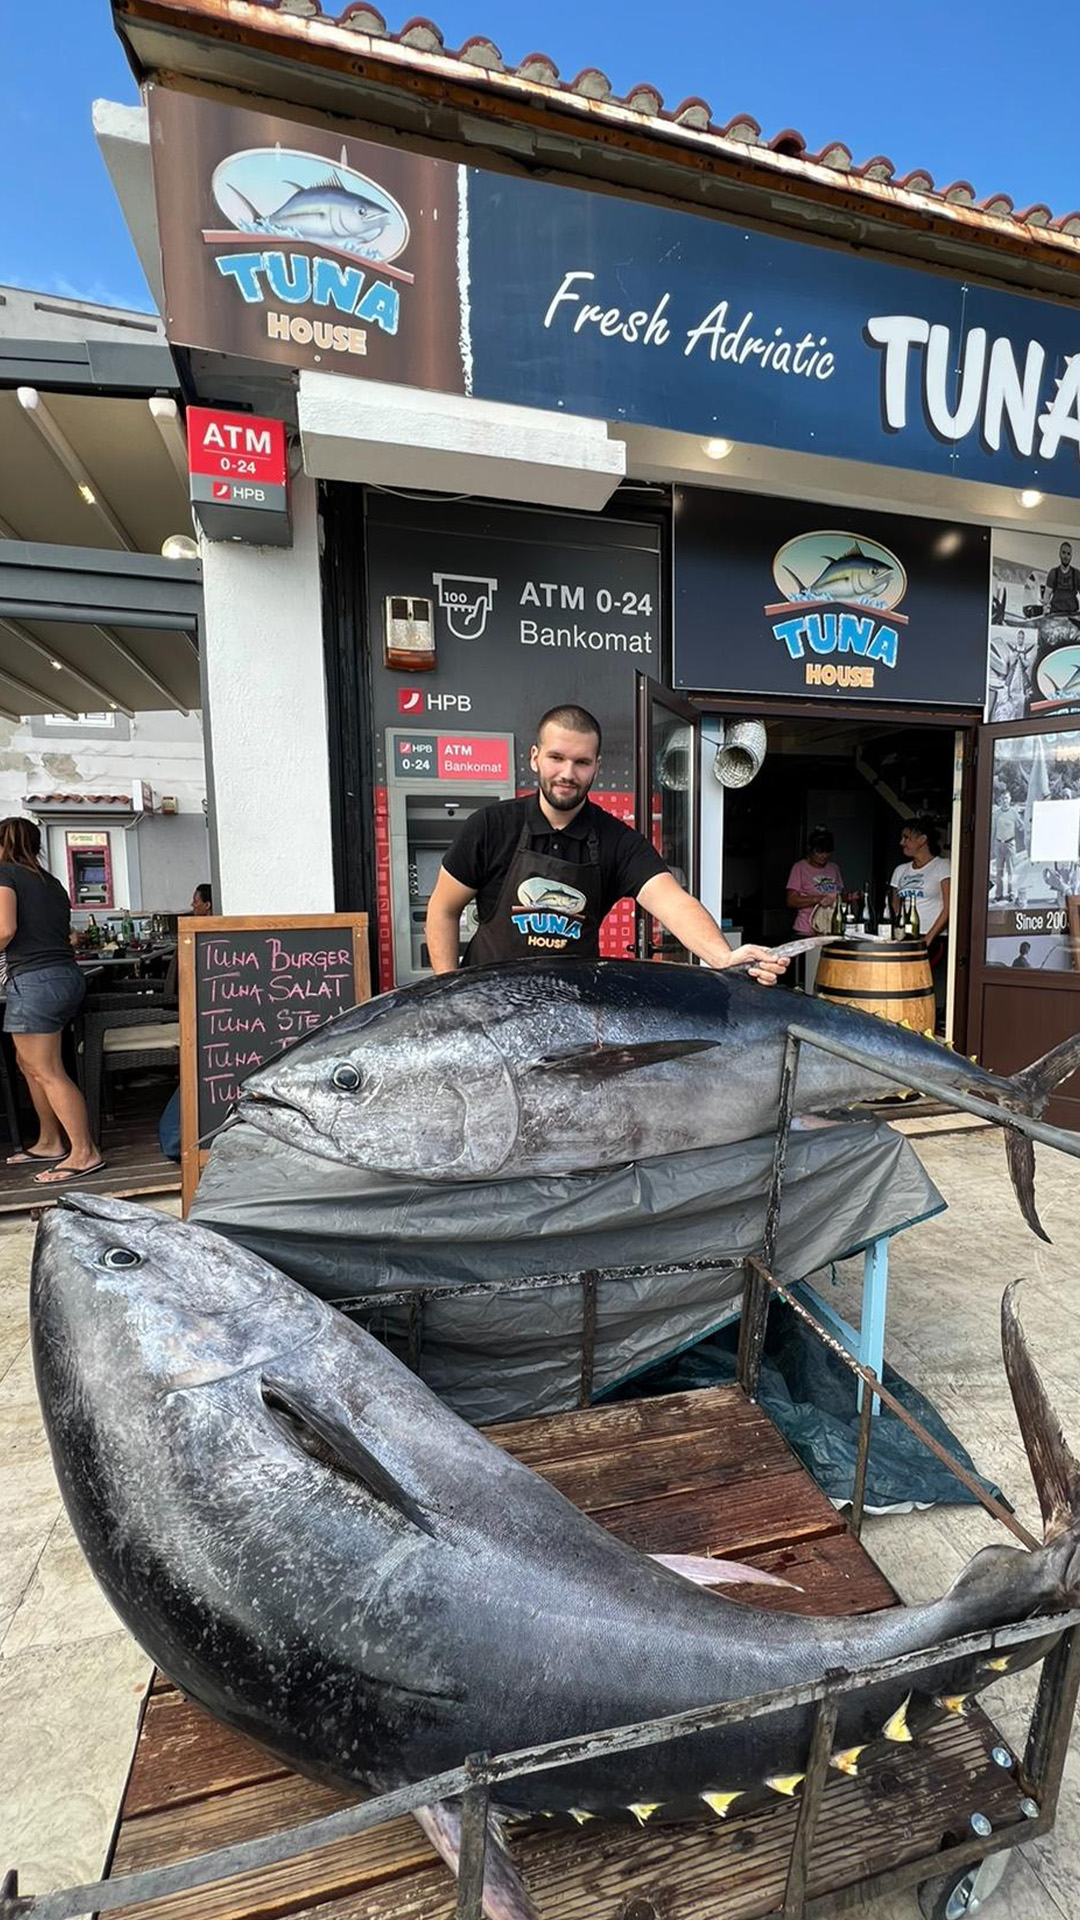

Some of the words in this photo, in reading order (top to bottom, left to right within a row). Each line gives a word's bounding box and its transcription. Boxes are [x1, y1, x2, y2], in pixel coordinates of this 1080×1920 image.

[216, 251, 400, 336] TUNA
[267, 311, 367, 355] HOUSE
[544, 271, 670, 346] Fresh
[684, 301, 835, 380] Adriatic
[202, 422, 271, 454] ATM
[220, 457, 256, 474] 0-24
[233, 486, 265, 501] HPB
[443, 591, 467, 603] 100
[519, 581, 585, 611] ATM
[596, 589, 653, 617] 0-24
[519, 619, 652, 653] Bankomat
[772, 612, 899, 669] TUNA
[805, 662, 874, 688] HOUSE
[427, 694, 472, 712] HPB
[412, 744, 433, 753] HPB
[444, 744, 472, 756] ATM
[402, 758, 430, 770] 0-24
[444, 760, 502, 773] Bankomat
[511, 912, 583, 940] TUNA
[1015, 911, 1044, 930] Since
[1046, 911, 1069, 929] 200
[200, 940, 260, 970] TUNA
[265, 938, 352, 972] BURGER
[527, 935, 568, 949] HOUSE
[202, 972, 264, 1005] TUNA
[268, 974, 349, 1002] SALAT
[201, 1008, 266, 1035] TUNA
[202, 1043, 264, 1068] TUNA
